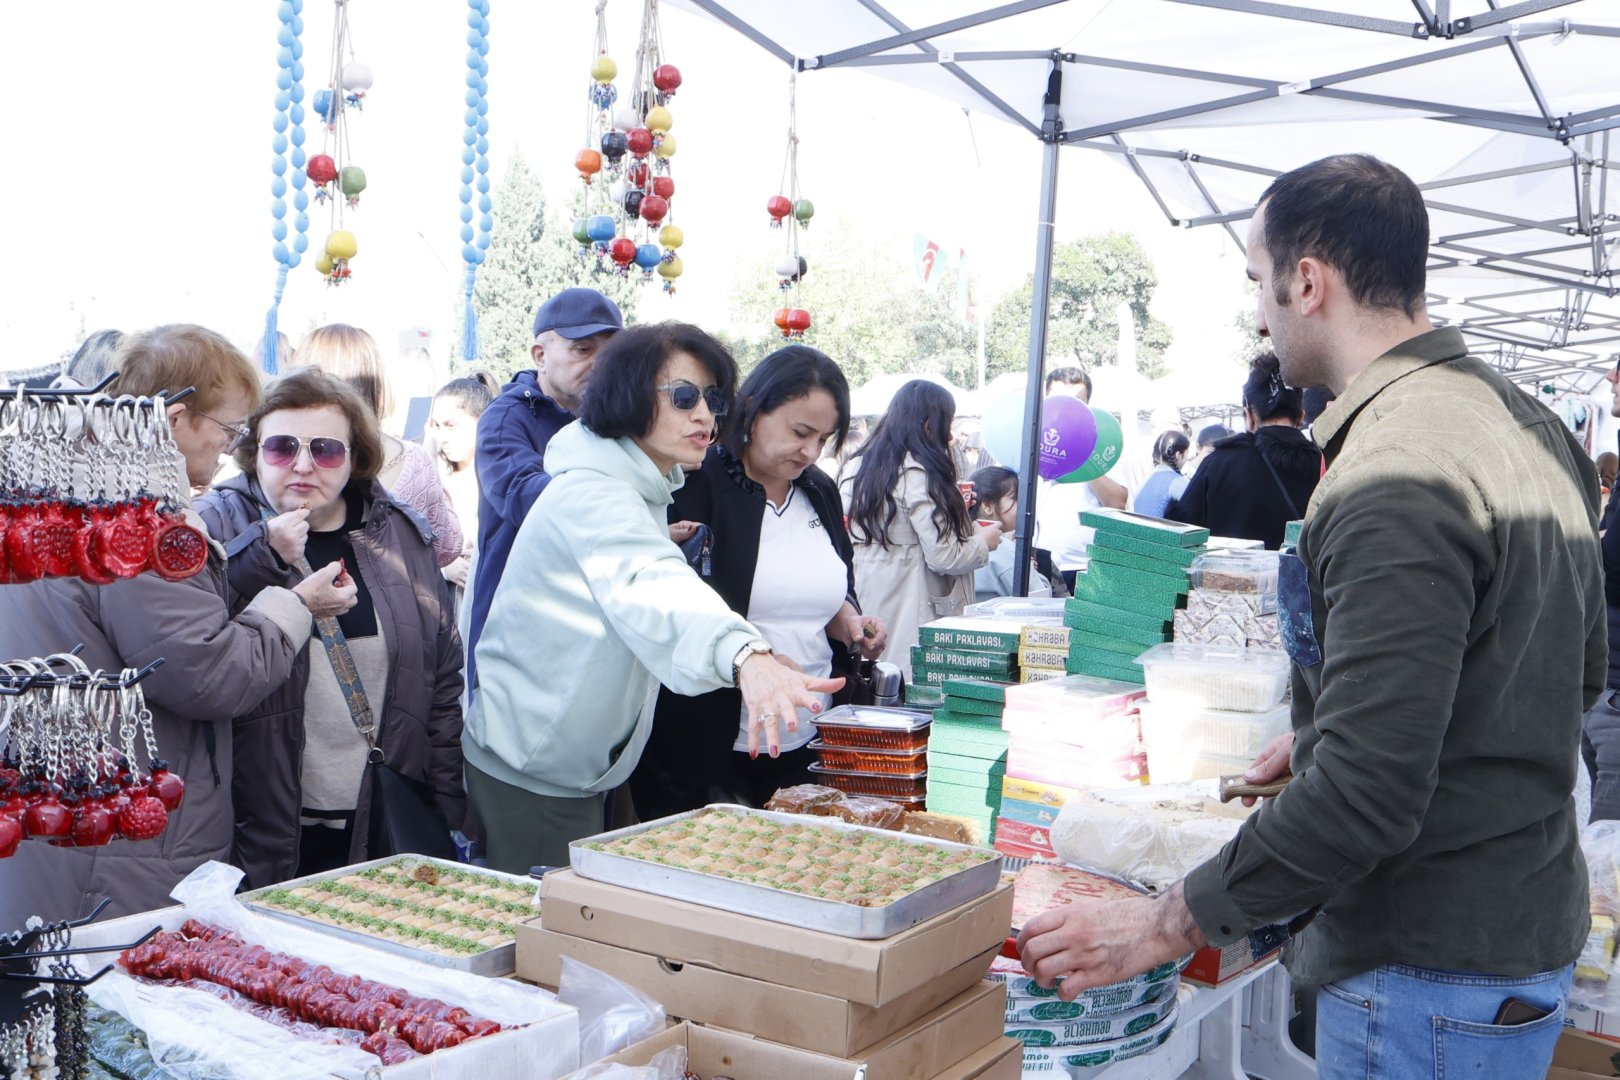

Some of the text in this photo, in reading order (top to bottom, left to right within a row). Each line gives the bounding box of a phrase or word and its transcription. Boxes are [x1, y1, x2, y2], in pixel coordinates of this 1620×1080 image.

[934, 632, 1001, 647] BAKI PAXLAVASI
[925, 653, 990, 668] BAKI PAXLAVASI
